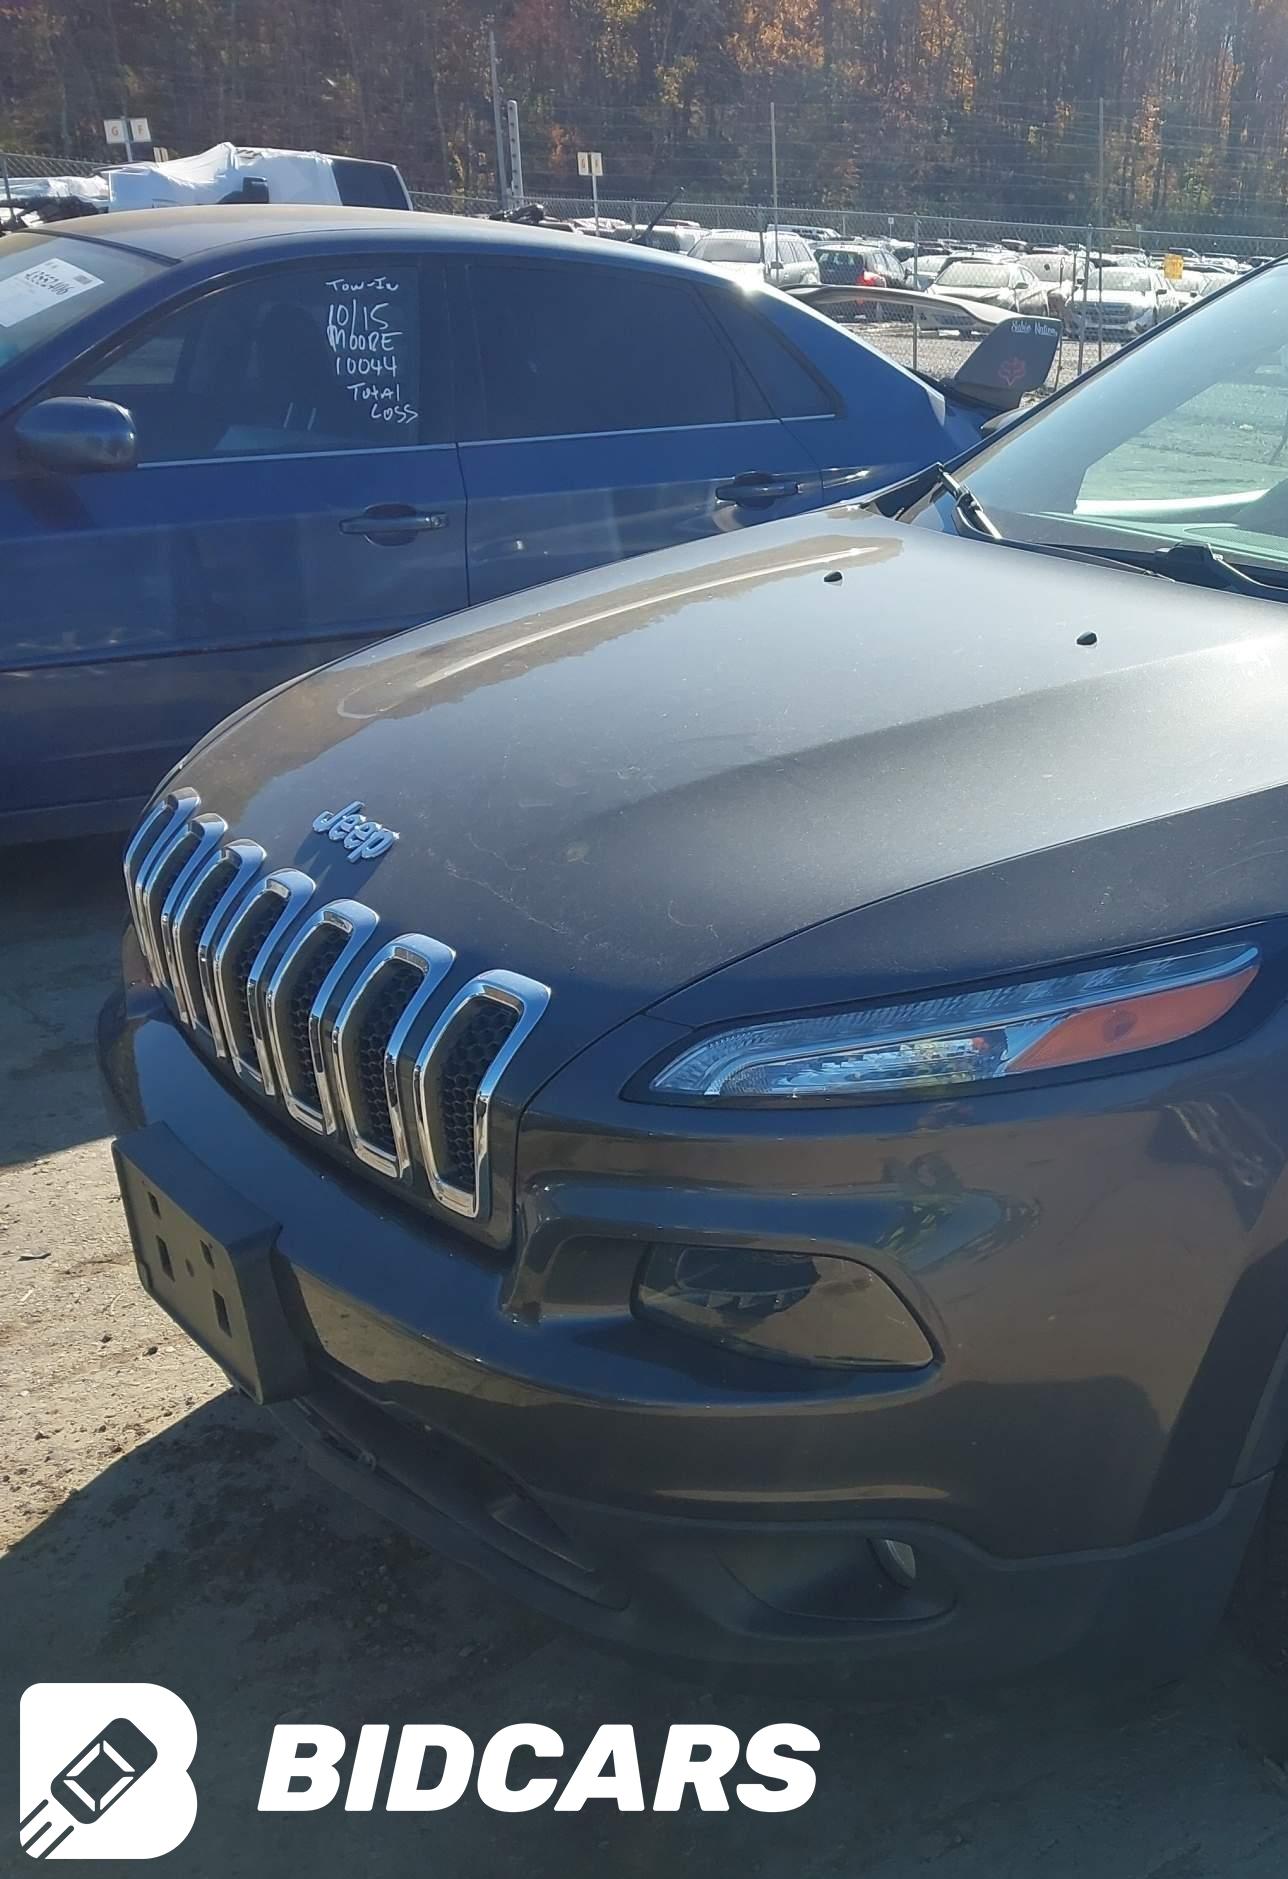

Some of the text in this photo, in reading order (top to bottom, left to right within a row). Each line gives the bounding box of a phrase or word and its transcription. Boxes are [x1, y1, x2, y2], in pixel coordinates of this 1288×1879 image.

[328, 299, 389, 333] 10/15
[327, 325, 403, 352] MOORE
[336, 355, 397, 377] 10044
[312, 800, 400, 863] Jeep
